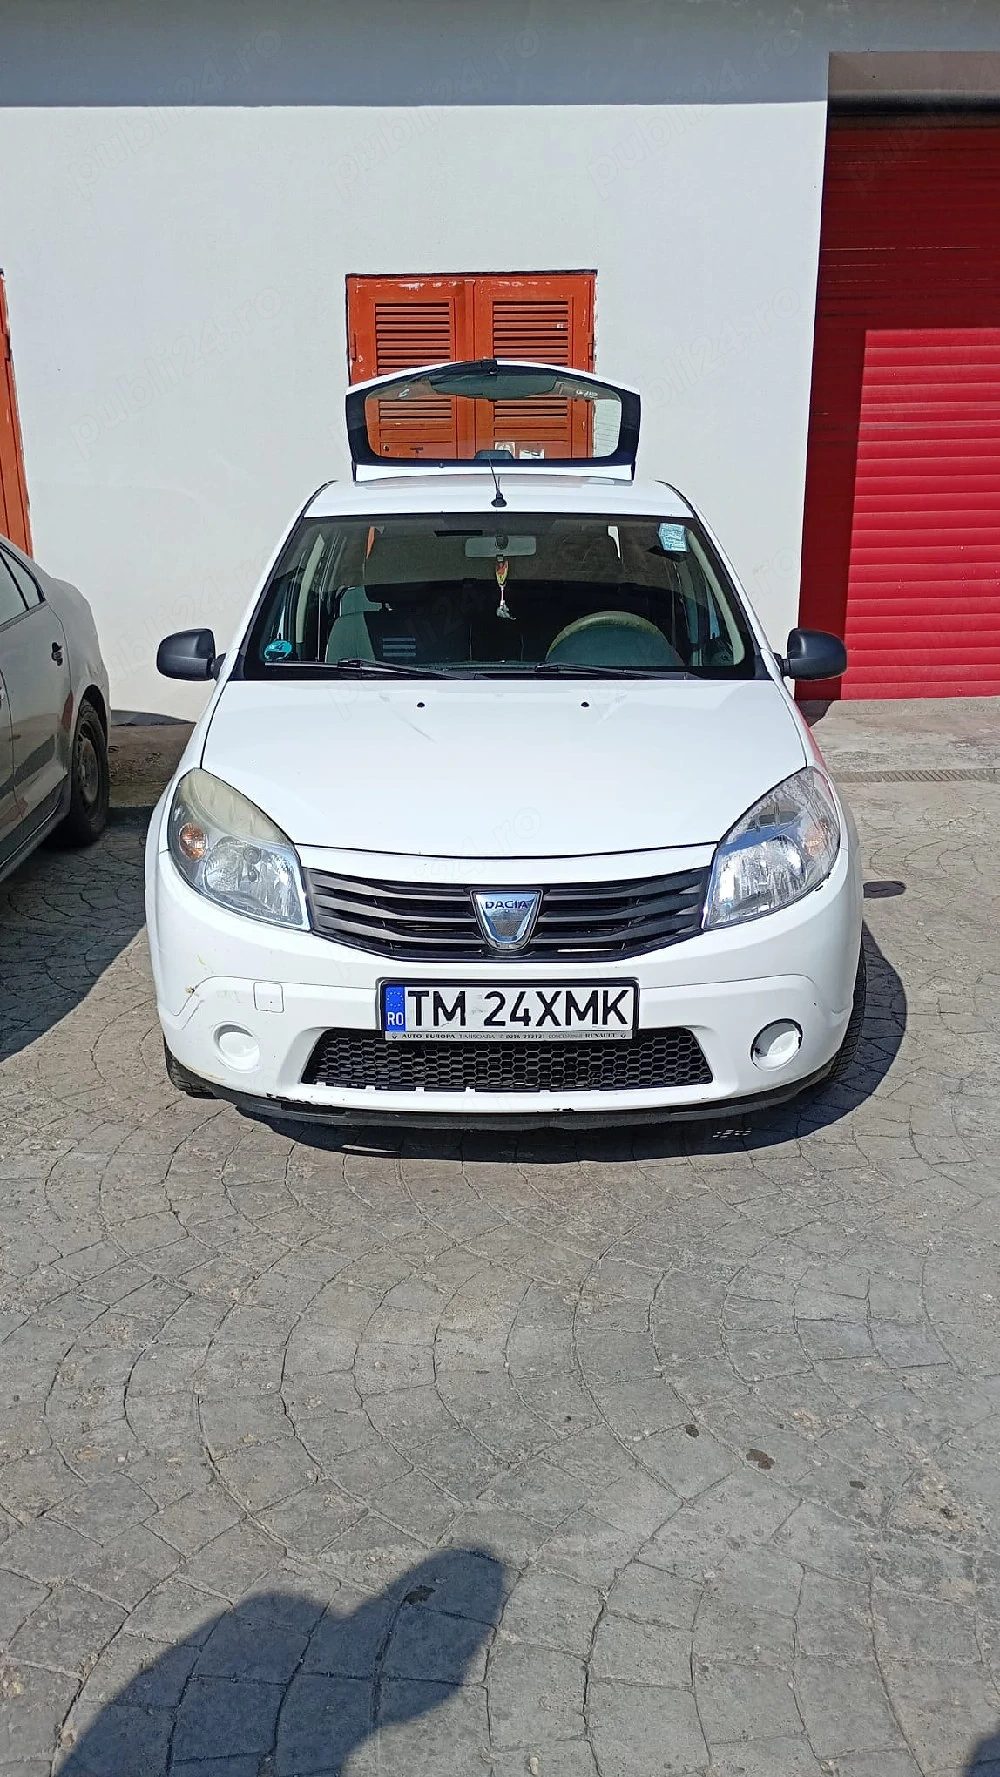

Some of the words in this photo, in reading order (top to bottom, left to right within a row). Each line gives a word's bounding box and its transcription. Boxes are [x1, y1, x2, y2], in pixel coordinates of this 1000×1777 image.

[485, 900, 528, 910] DACIA
[408, 990, 467, 1026] TM
[484, 989, 629, 1026] 24XMK
[387, 1011, 404, 1026] RO
